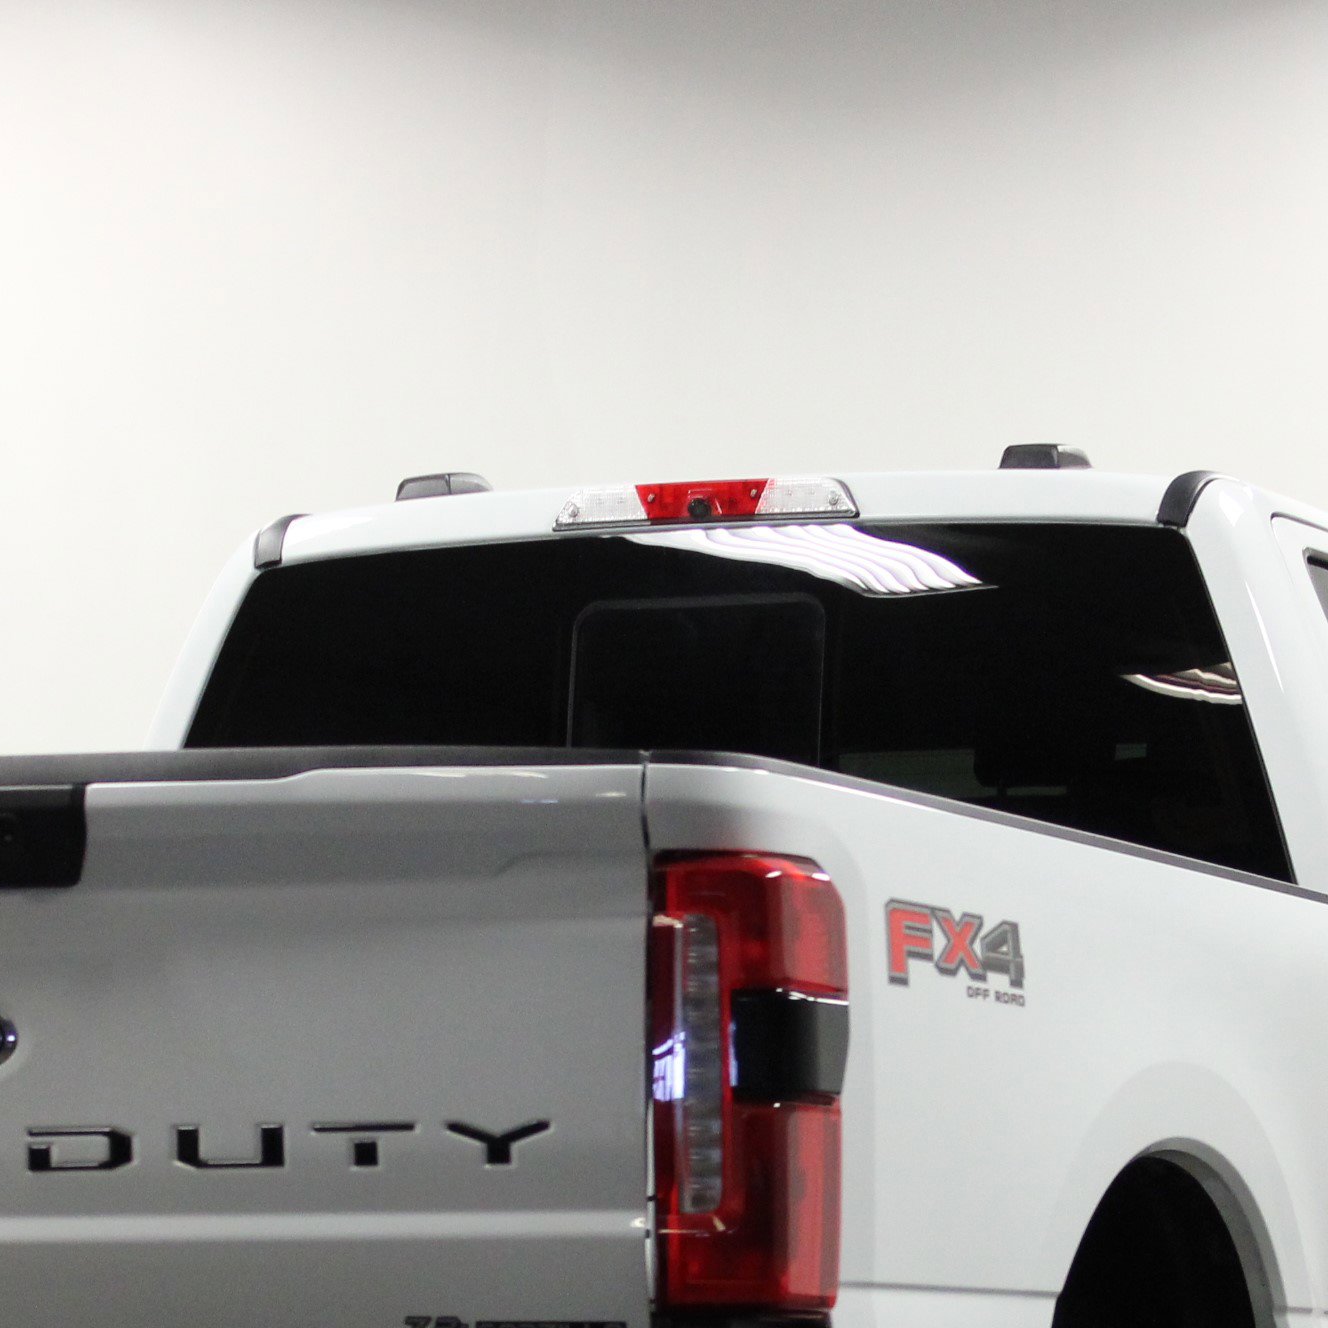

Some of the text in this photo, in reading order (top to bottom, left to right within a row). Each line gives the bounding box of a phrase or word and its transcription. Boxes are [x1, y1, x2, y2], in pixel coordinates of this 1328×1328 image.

[884, 897, 1025, 989] FX4
[966, 985, 1025, 1006] OFF ROAD
[27, 1120, 552, 1171] DUTY
